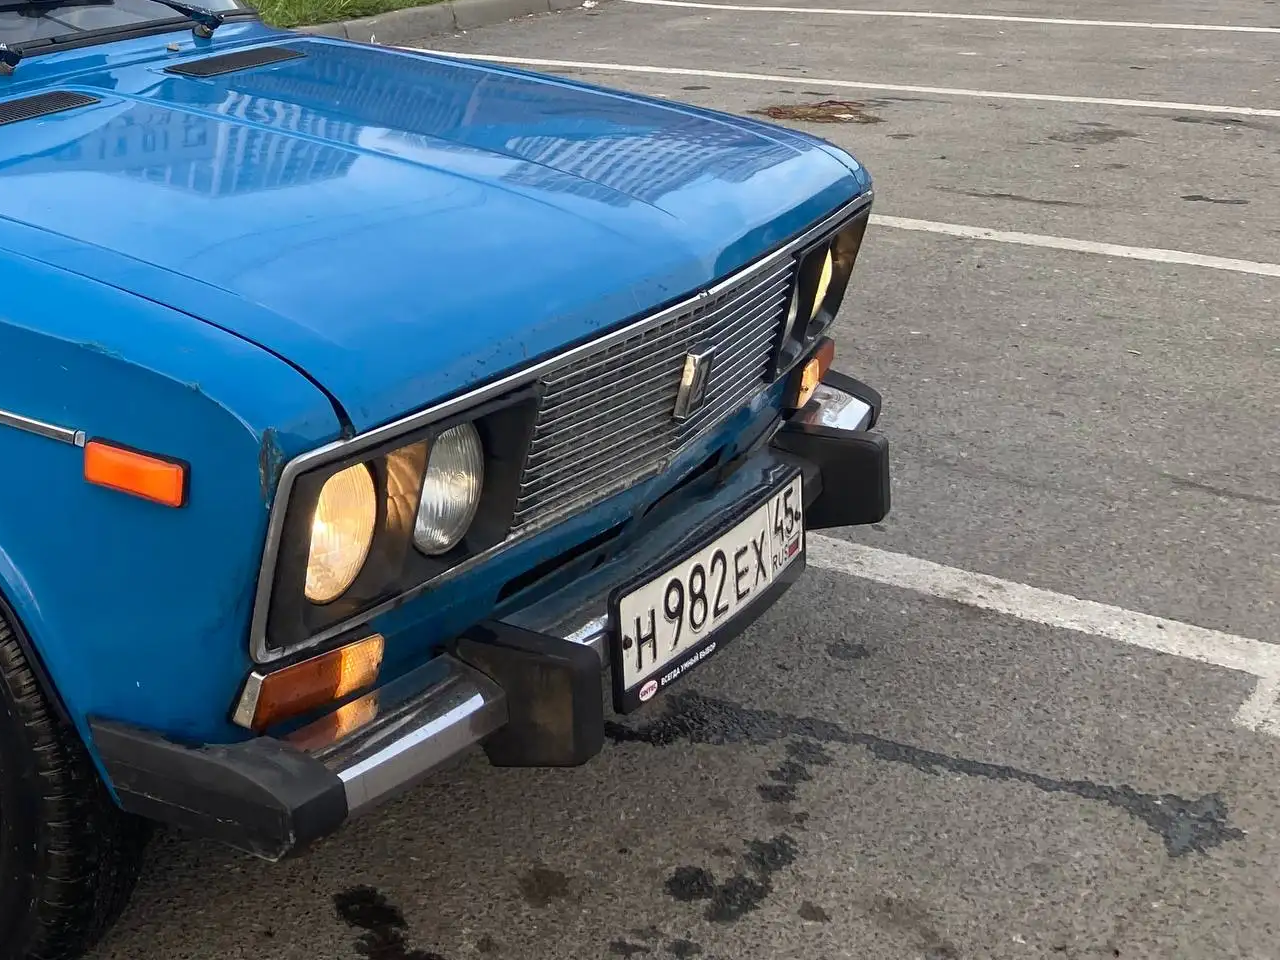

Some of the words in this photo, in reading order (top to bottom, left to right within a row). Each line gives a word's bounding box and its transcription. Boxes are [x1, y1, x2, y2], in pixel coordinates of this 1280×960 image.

[773, 487, 795, 542] 45
[772, 543, 789, 572] RUS
[661, 667, 680, 686] ВСЕГДА
